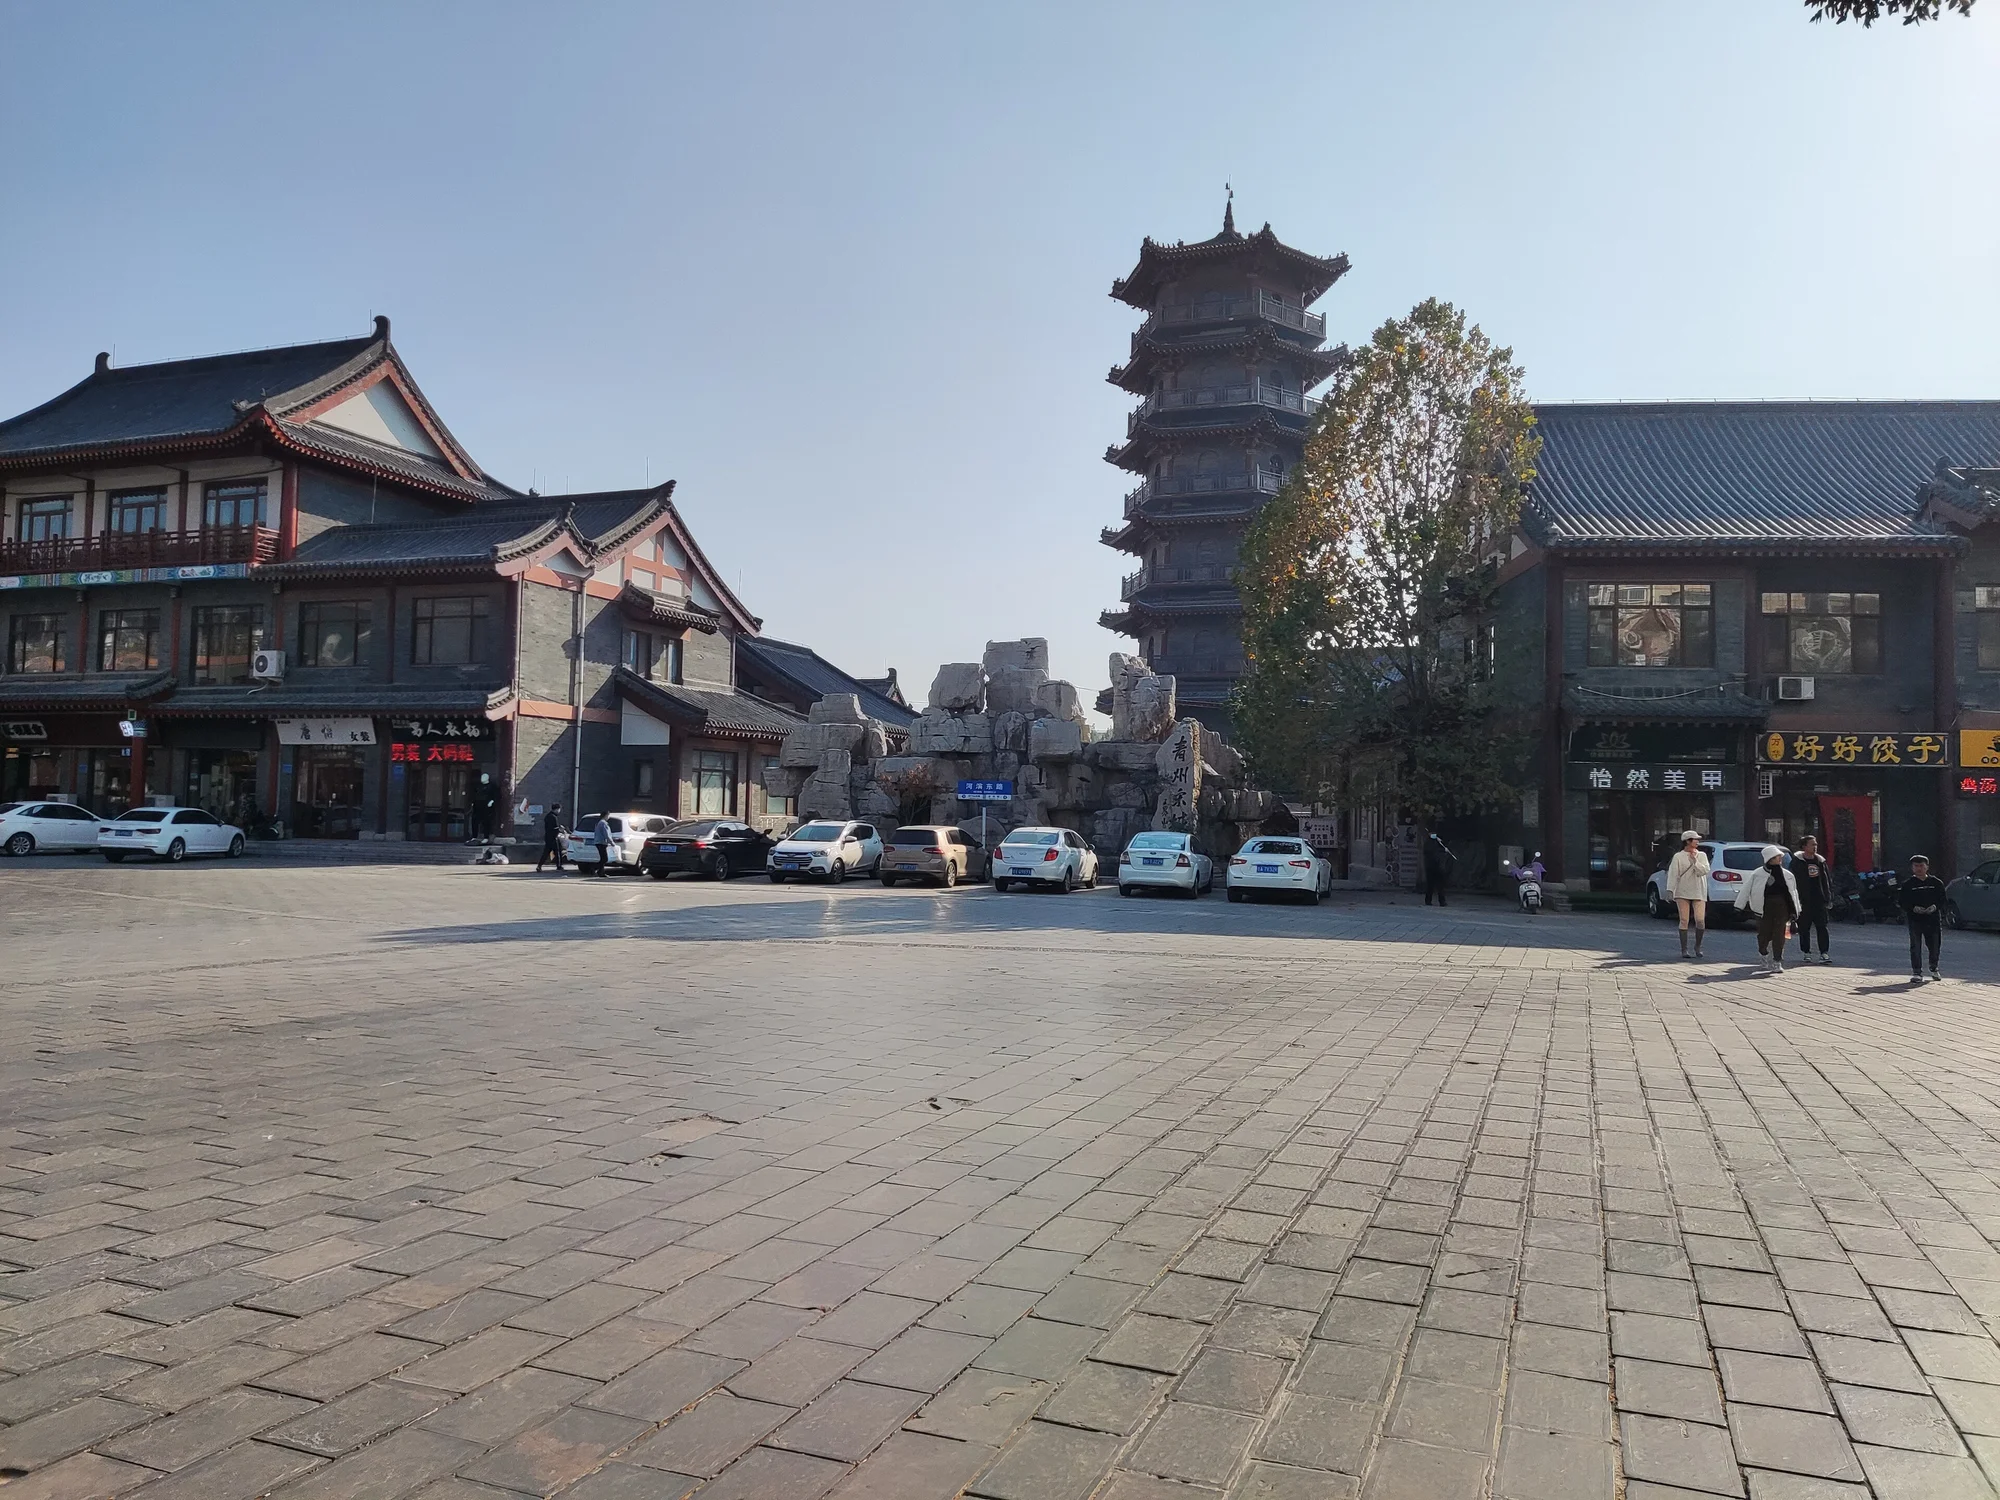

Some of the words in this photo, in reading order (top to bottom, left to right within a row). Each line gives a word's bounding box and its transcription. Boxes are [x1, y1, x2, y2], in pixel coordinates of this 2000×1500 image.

[391, 743, 420, 761] 男装
[1792, 735, 1941, 764] 好好饺子
[1171, 735, 1189, 829] 青州宋城
[1589, 768, 1723, 790] 怡然美甲
